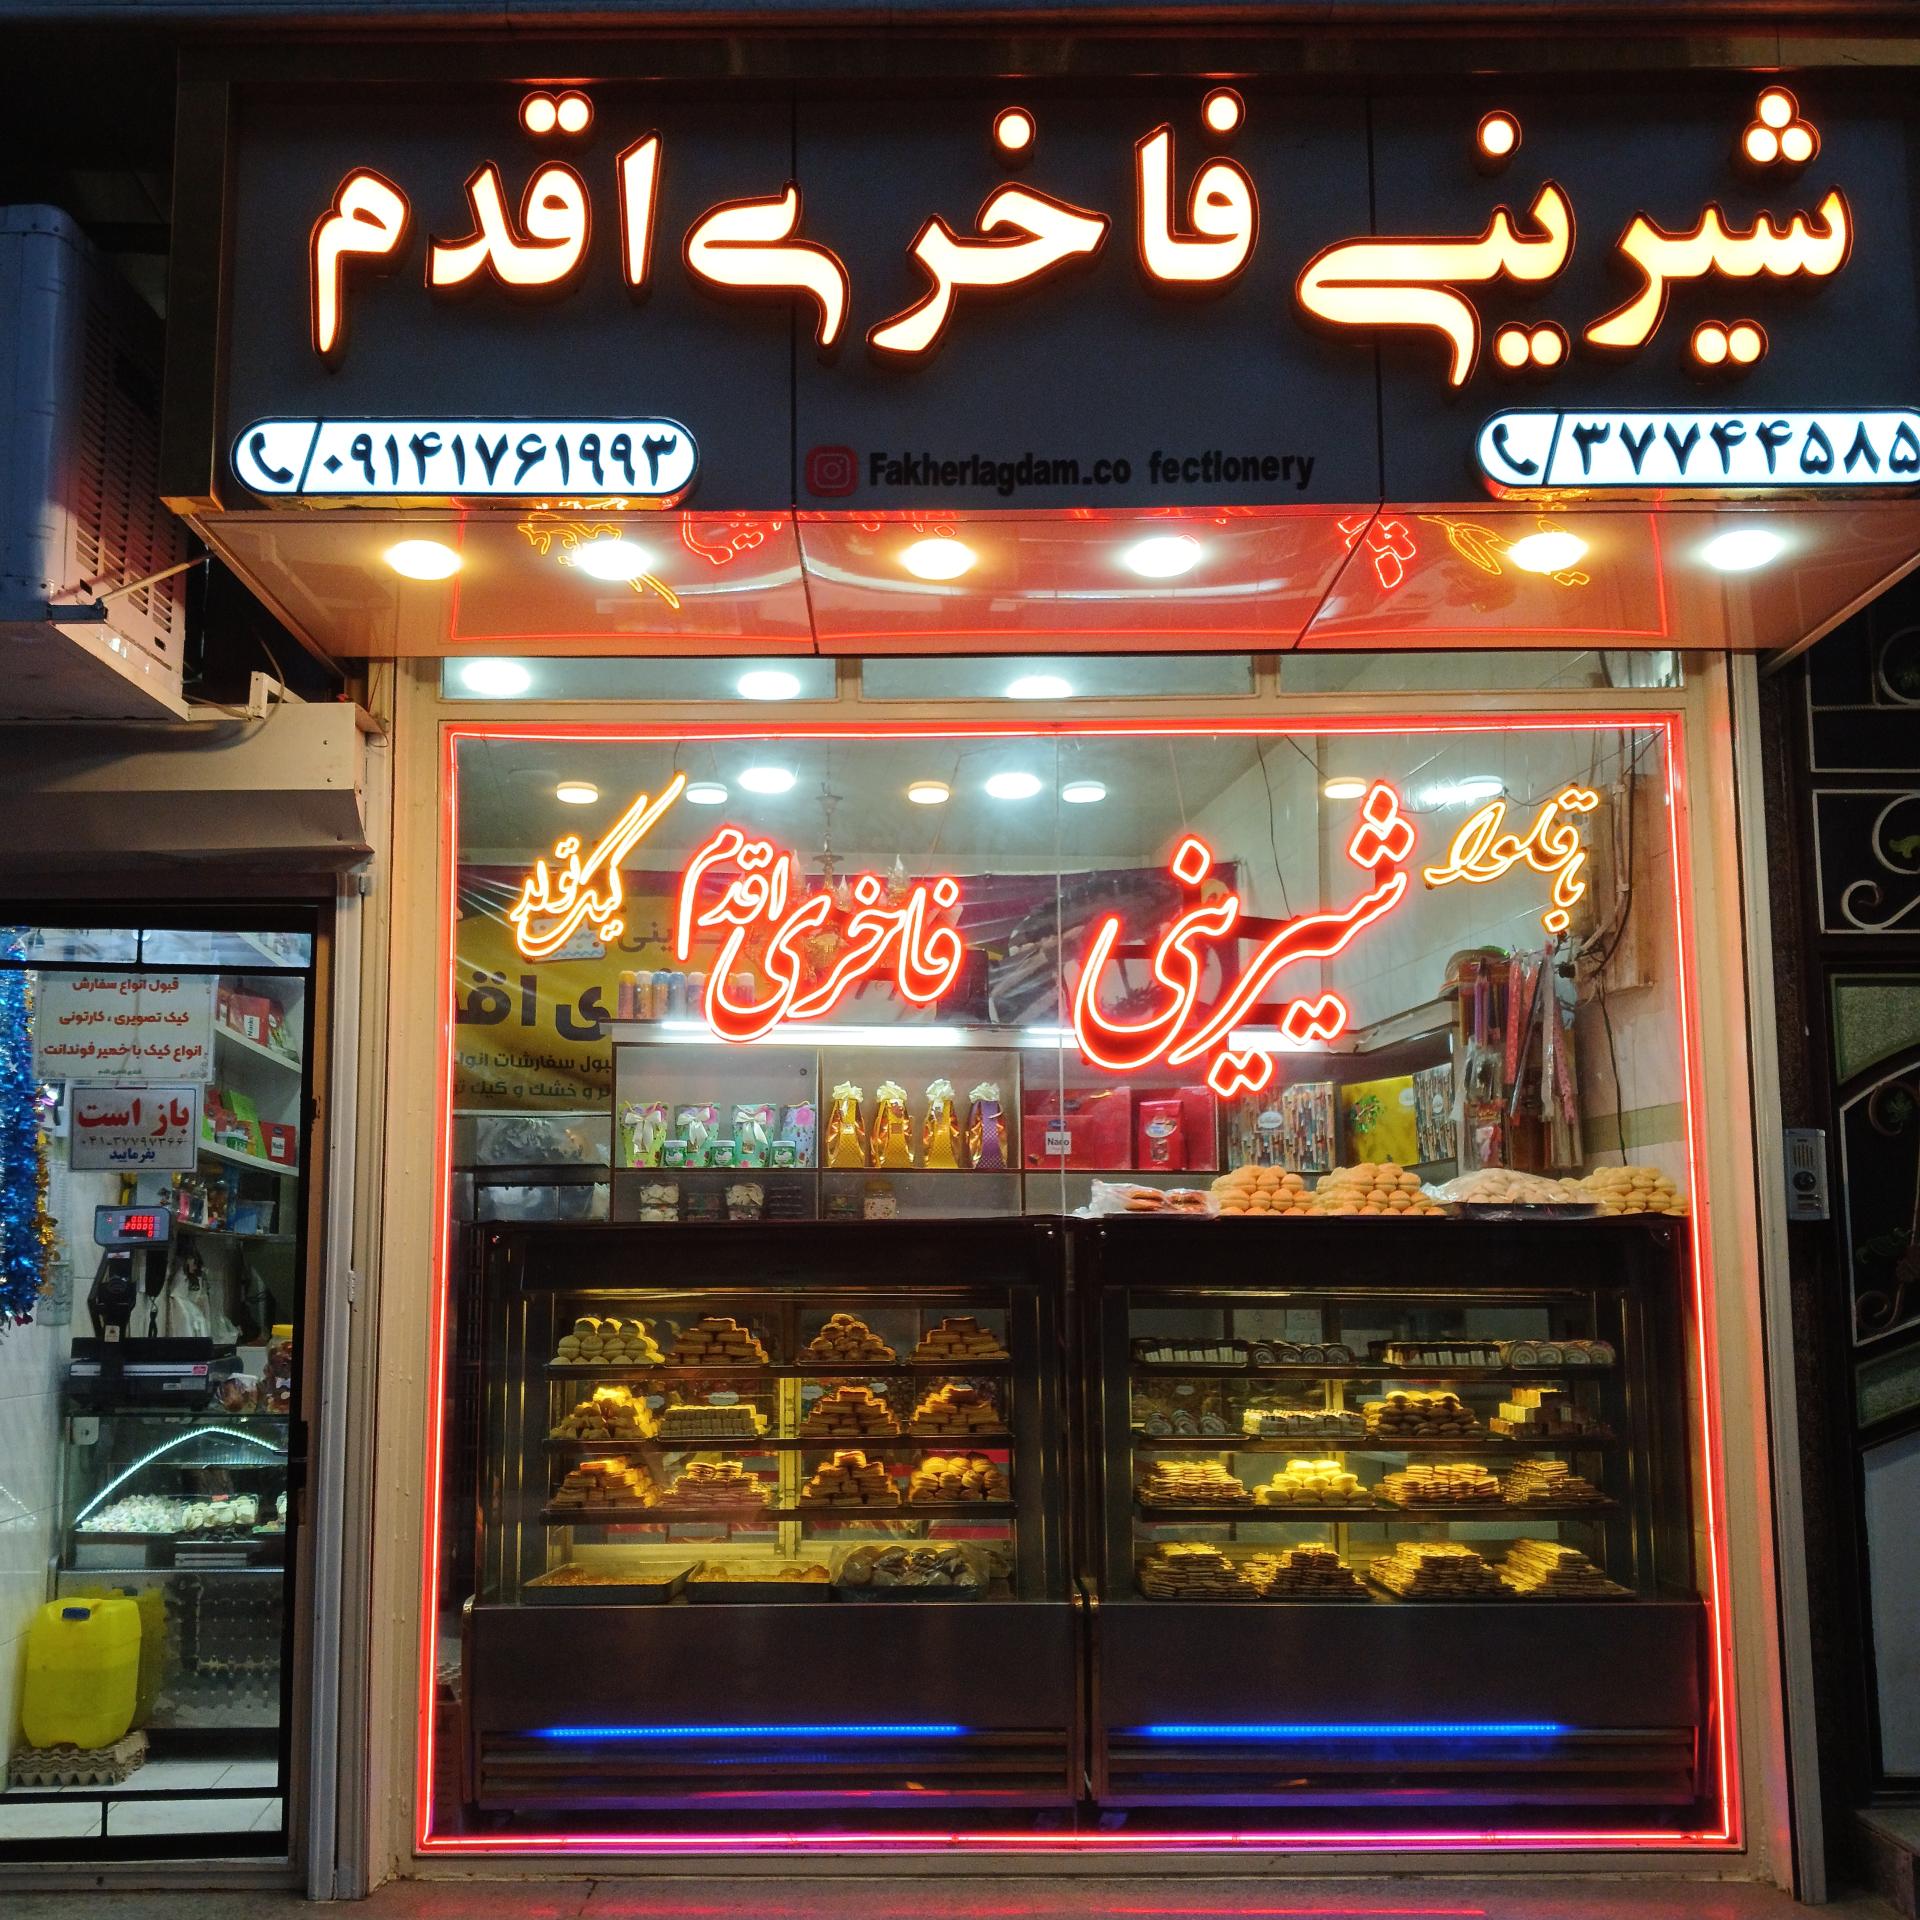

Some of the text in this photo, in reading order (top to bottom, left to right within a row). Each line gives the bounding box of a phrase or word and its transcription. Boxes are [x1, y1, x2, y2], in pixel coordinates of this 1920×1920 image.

[310, 86, 1853, 386] شیرینی فاخری اقدم
[1573, 419, 1920, 476] ۳۷۷۴۴۵۸۵
[322, 431, 678, 487] ۰۹۱۴۱۷۶۱۹۹۳
[1423, 787, 1600, 934] باقلوا
[677, 782, 1417, 1098] شیرینی فاخری اقدم
[72, 976, 179, 995] قبول انواع سفارش
[59, 1011, 105, 1026] کارتونی
[113, 1011, 163, 1027] تصویری
[163, 1012, 190, 1026] کیک
[43, 1041, 96, 1060] فوندانت
[96, 1043, 131, 1060] خمیر
[143, 1044, 172, 1060] کیک
[172, 1044, 203, 1062] انواع
[77, 1097, 190, 1137] باز است
